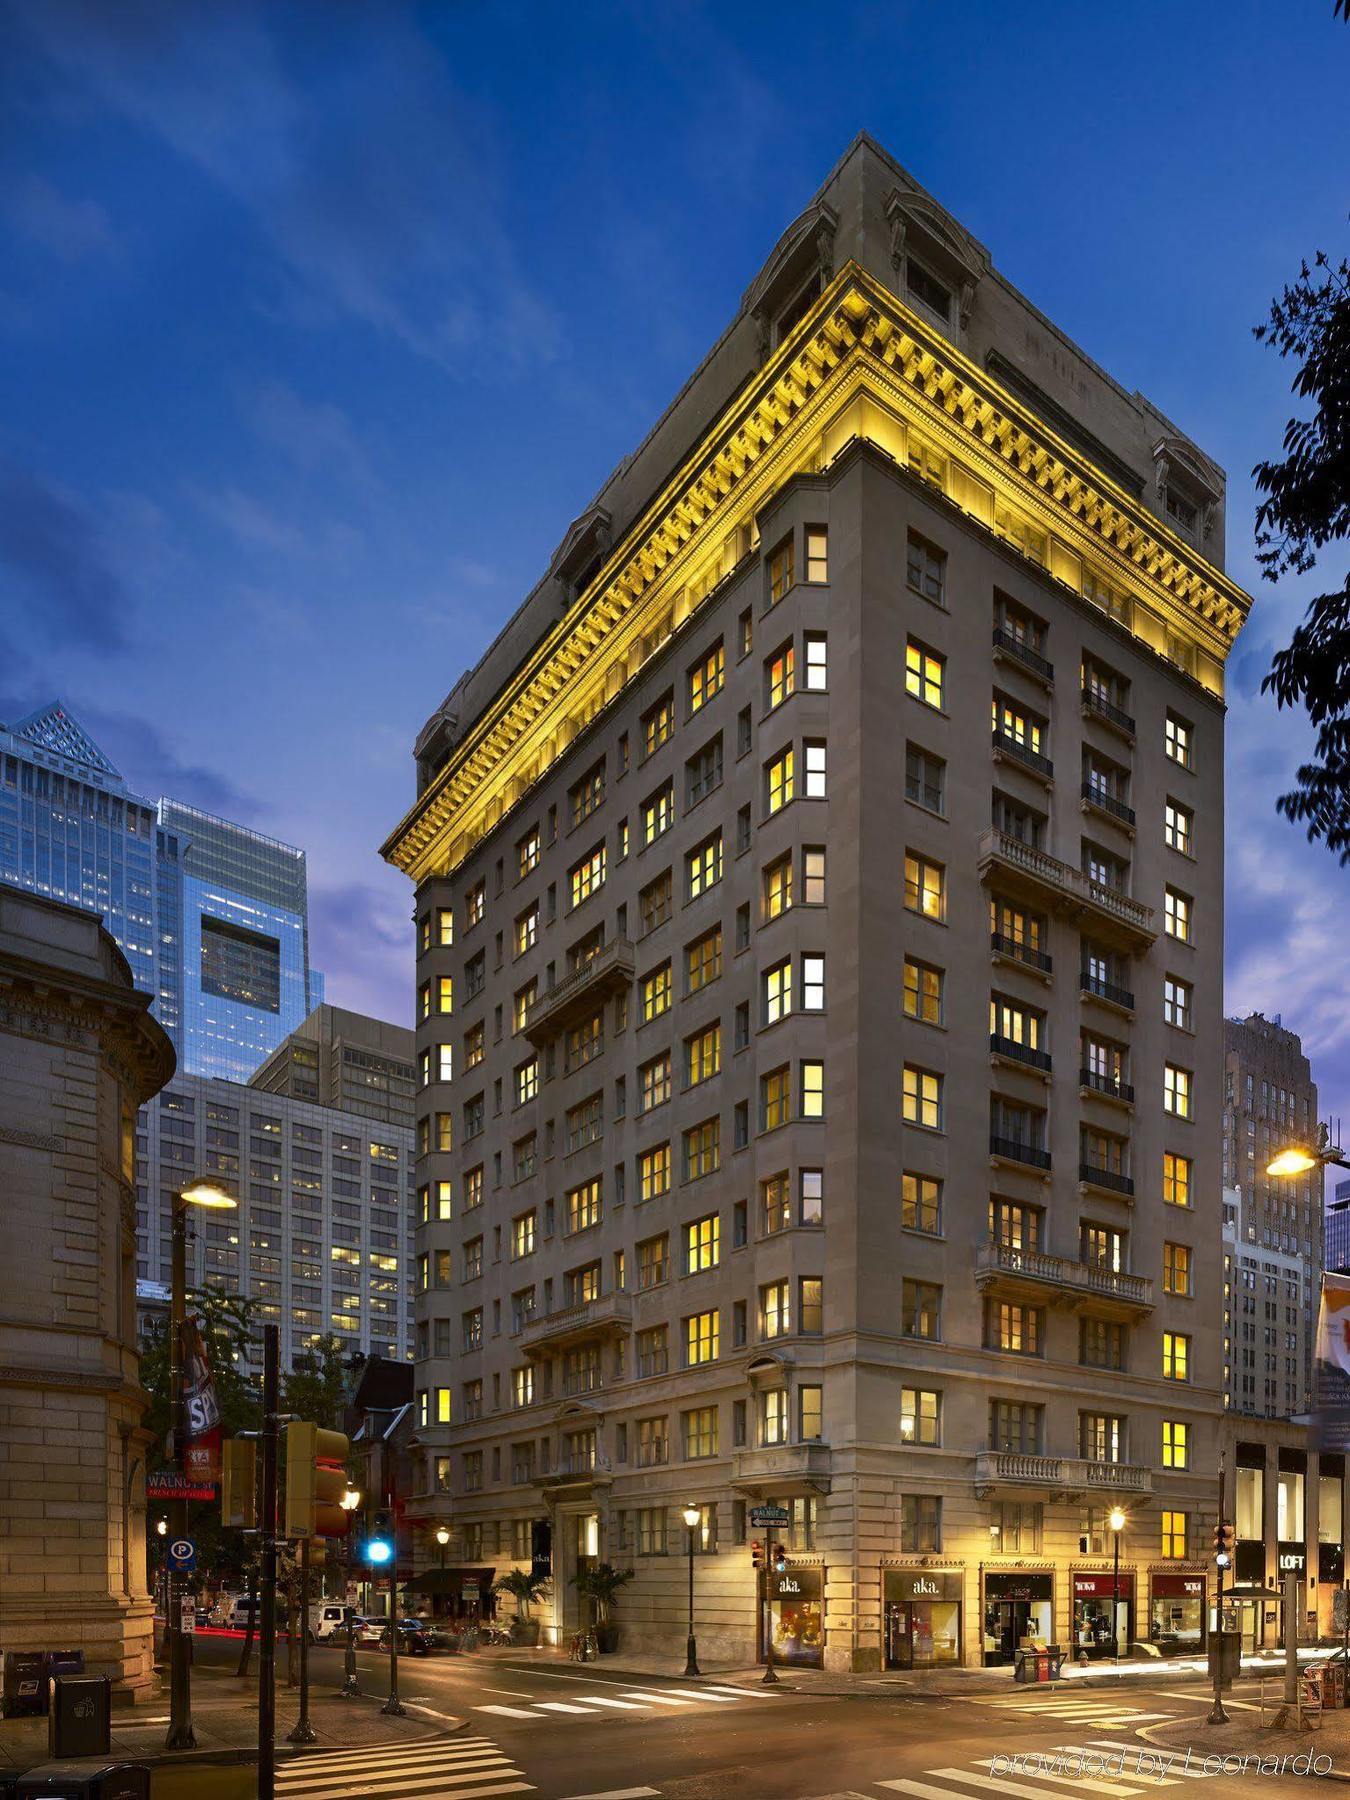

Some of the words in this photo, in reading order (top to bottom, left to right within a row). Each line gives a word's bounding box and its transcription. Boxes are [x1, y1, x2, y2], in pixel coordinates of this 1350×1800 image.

[1280, 1555, 1304, 1569] LOFT
[779, 1577, 800, 1593] aka.
[913, 1577, 939, 1594] aka.
